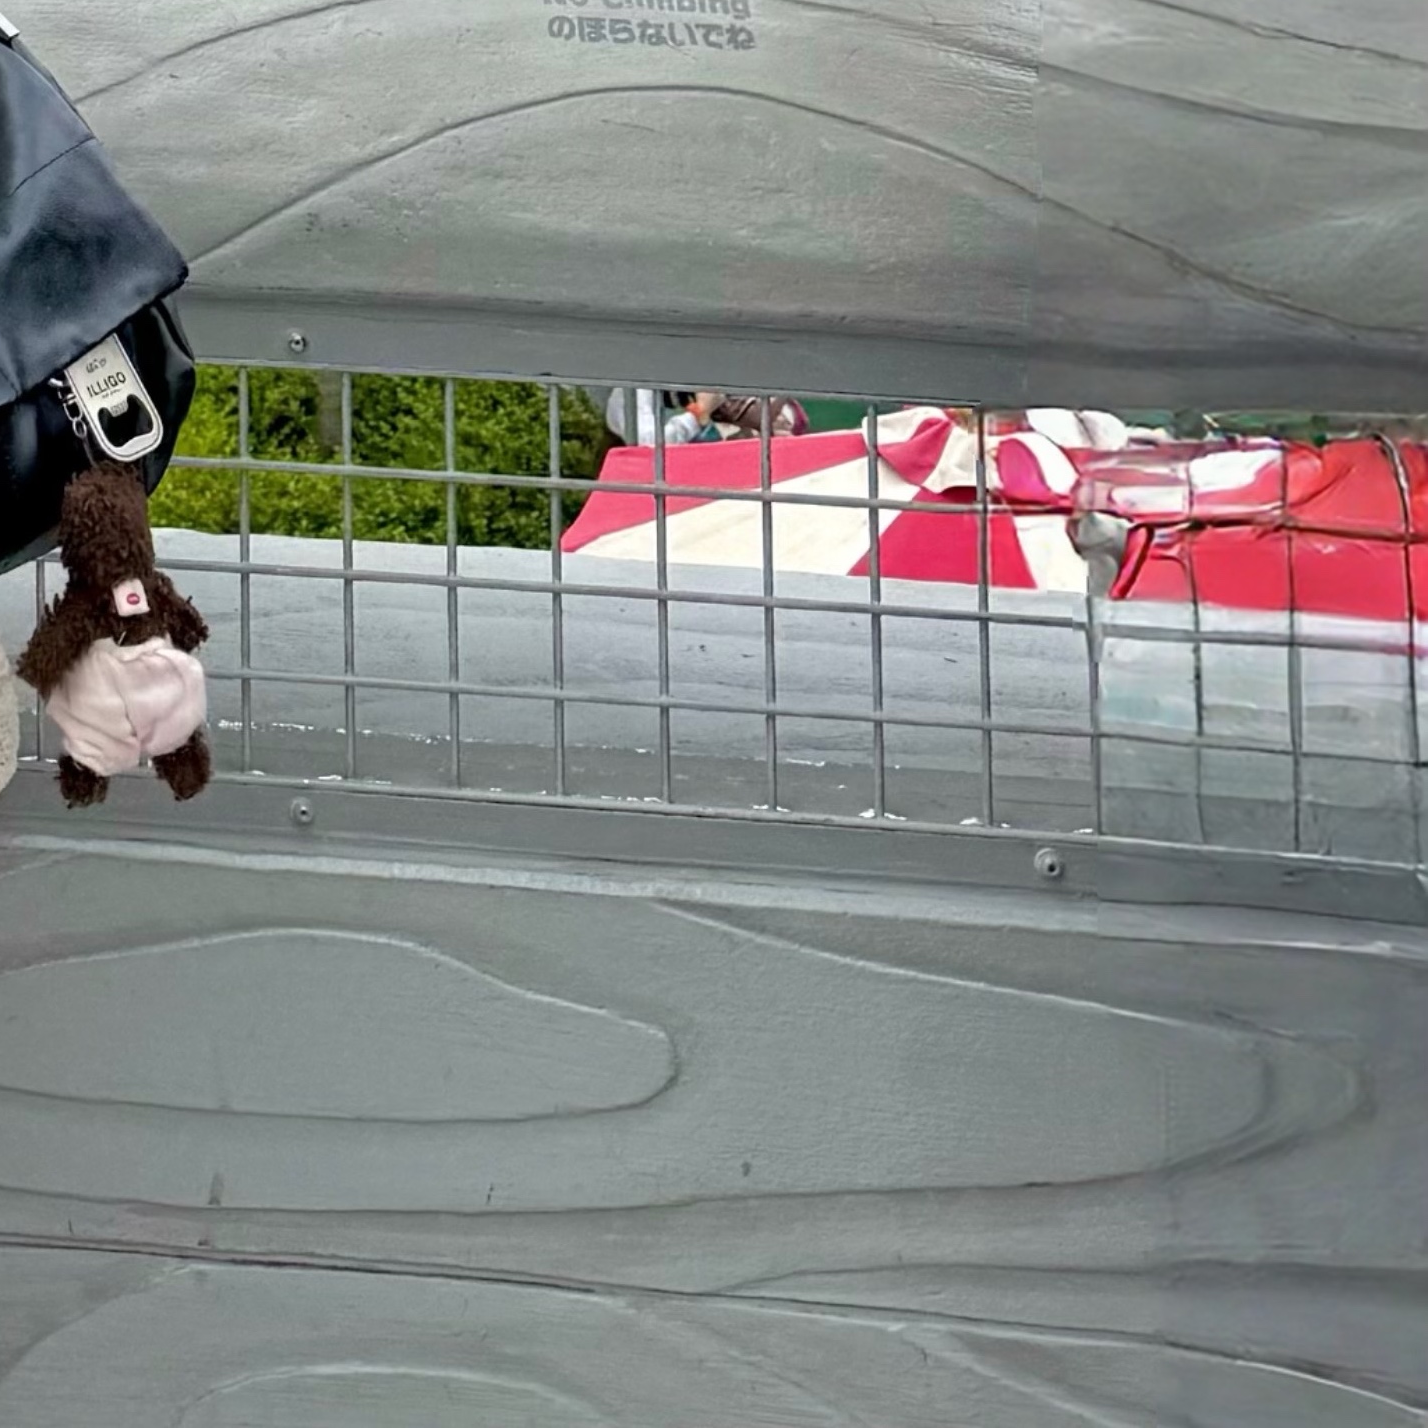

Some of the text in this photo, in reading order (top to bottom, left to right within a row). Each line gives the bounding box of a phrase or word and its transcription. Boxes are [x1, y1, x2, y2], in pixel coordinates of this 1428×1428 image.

[547, 15, 757, 50] のぼらないでね
